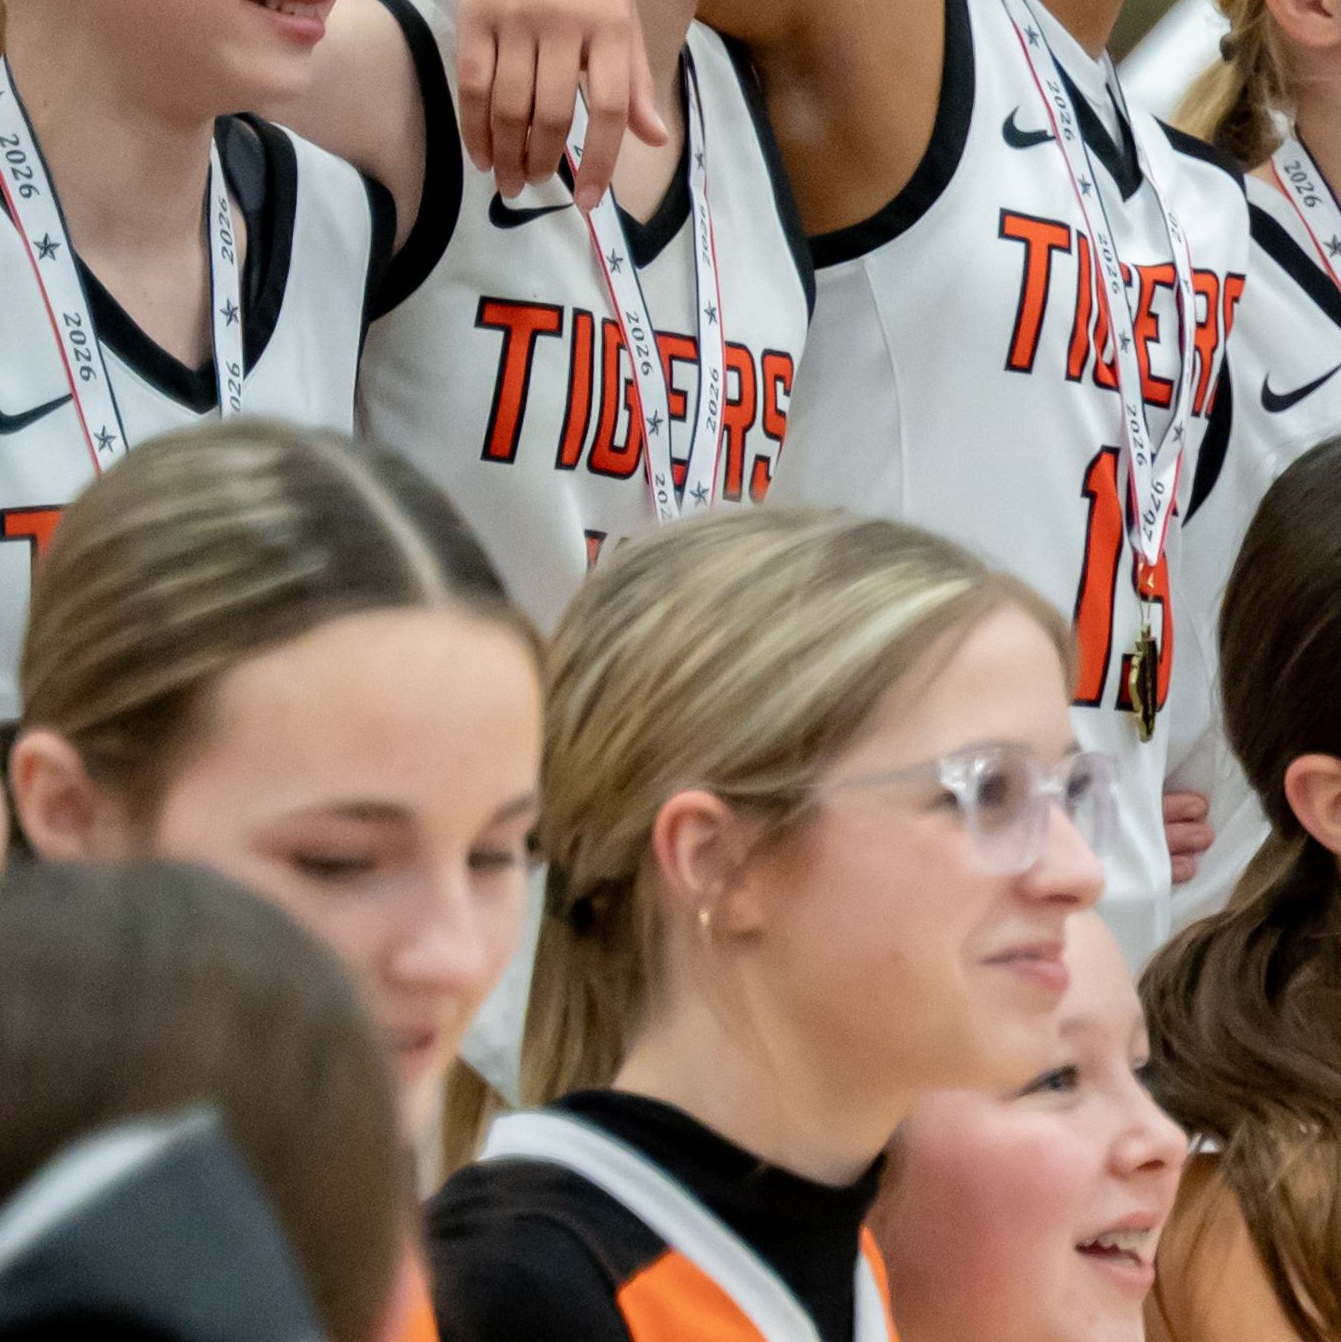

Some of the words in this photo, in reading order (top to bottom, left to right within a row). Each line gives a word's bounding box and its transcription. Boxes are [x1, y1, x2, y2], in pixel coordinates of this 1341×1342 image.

[1047, 79, 1077, 142] 2026
[1285, 160, 1320, 209] 2026
[220, 197, 237, 265] 2026
[1097, 234, 1120, 296] 2026
[62, 312, 98, 382] 2026
[625, 310, 654, 377] 2026
[704, 367, 721, 435] 2026
[1125, 404, 1148, 467] 2026
